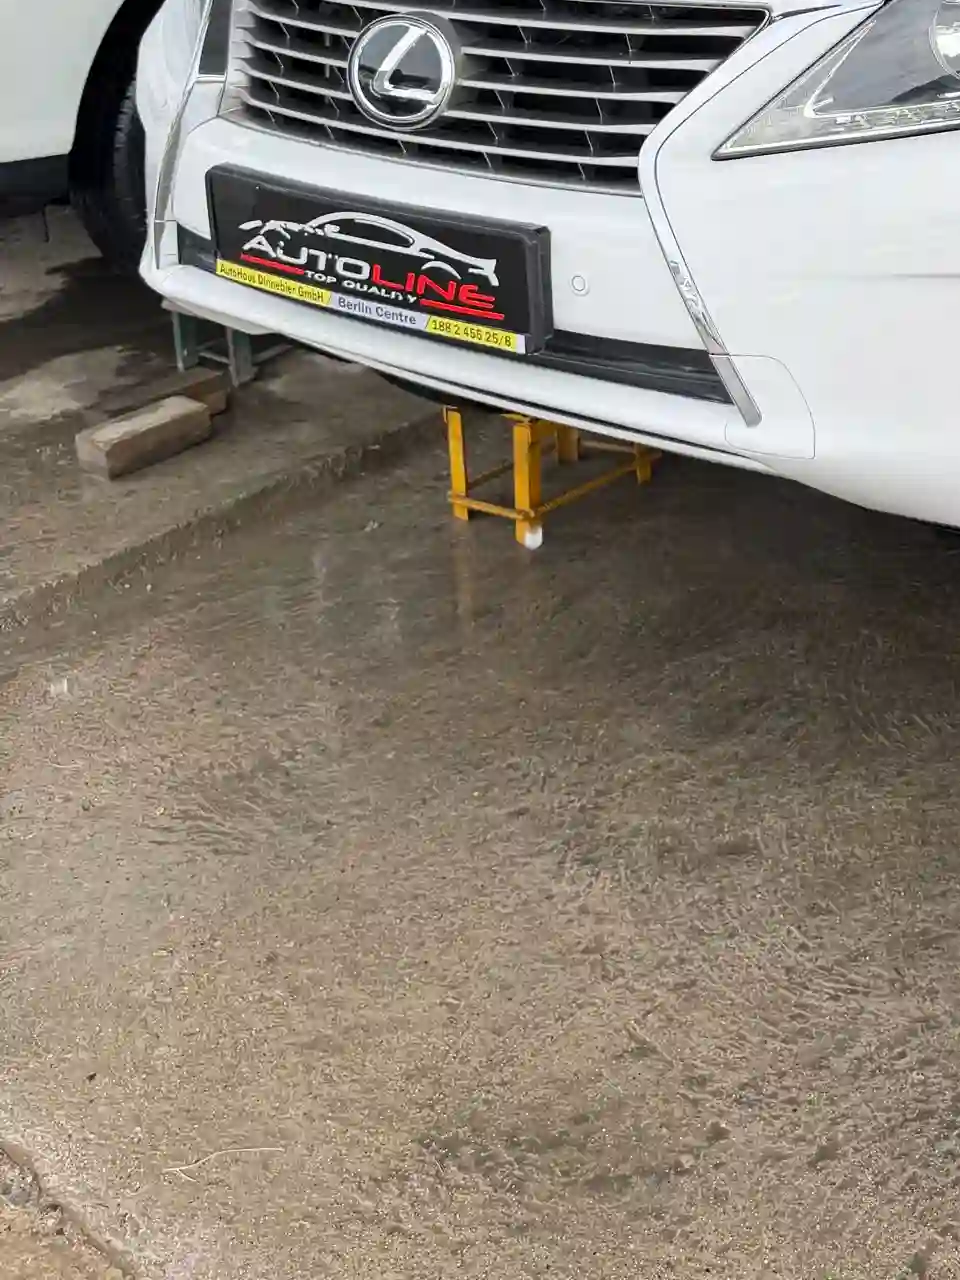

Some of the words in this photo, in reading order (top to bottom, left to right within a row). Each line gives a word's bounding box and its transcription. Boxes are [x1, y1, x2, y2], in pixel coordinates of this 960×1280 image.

[241, 235, 496, 310] AUTOLINE
[304, 269, 337, 285] TOP
[345, 280, 418, 305] QUALITY
[297, 286, 325, 303] GmbH
[338, 295, 371, 314] Berlin
[375, 305, 417, 325] Centre
